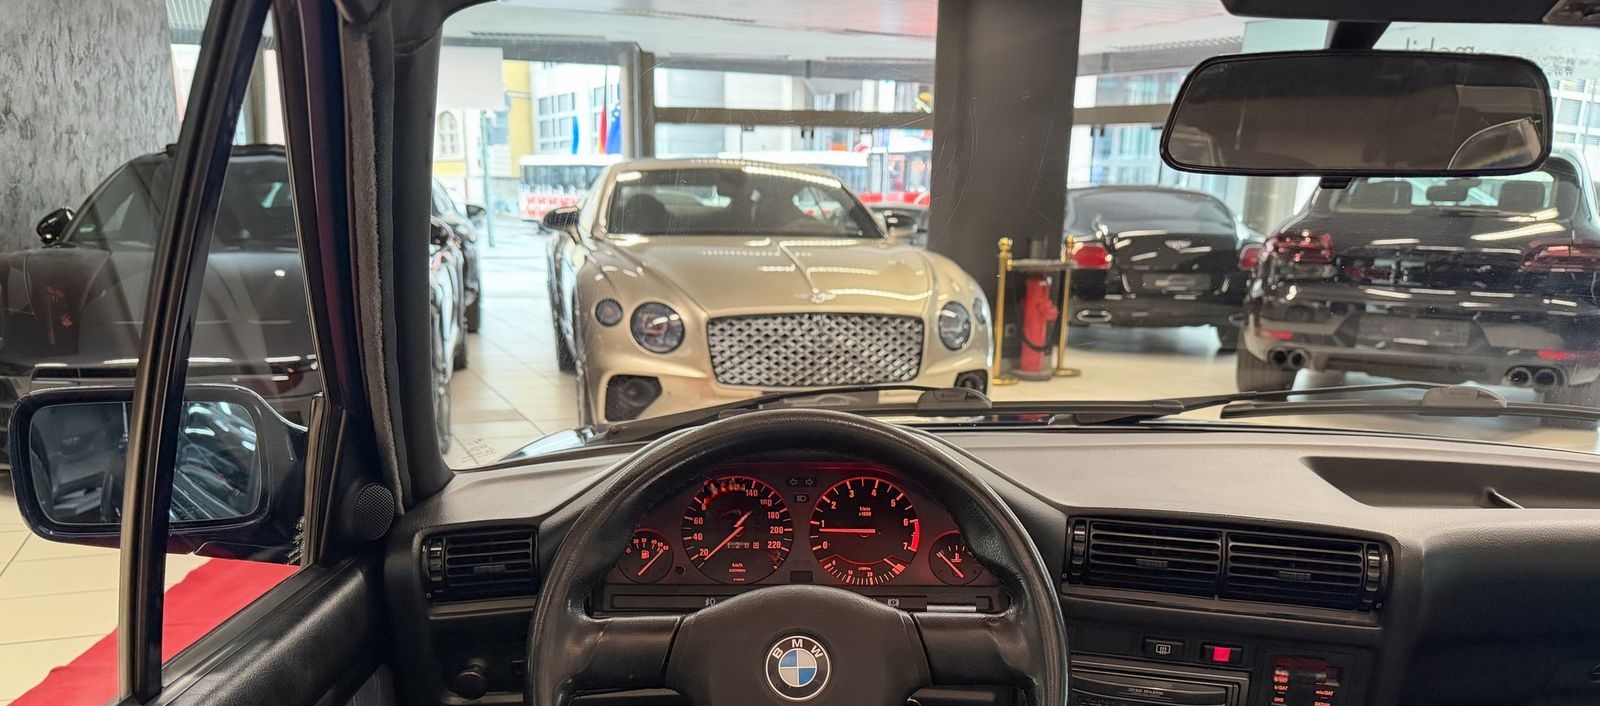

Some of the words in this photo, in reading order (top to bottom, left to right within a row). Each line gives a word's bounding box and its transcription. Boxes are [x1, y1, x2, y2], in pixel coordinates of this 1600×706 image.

[746, 489, 758, 497] 140
[849, 490, 855, 498] 3
[871, 489, 877, 497] 4
[890, 499, 896, 507] 5
[693, 517, 703, 525] 60
[903, 518, 909, 526] 6
[769, 526, 784, 534] 200
[693, 533, 703, 541] 40
[767, 541, 781, 549] 220
[822, 541, 828, 549] 0
[699, 548, 709, 557] 20
[772, 638, 824, 660] BMW
